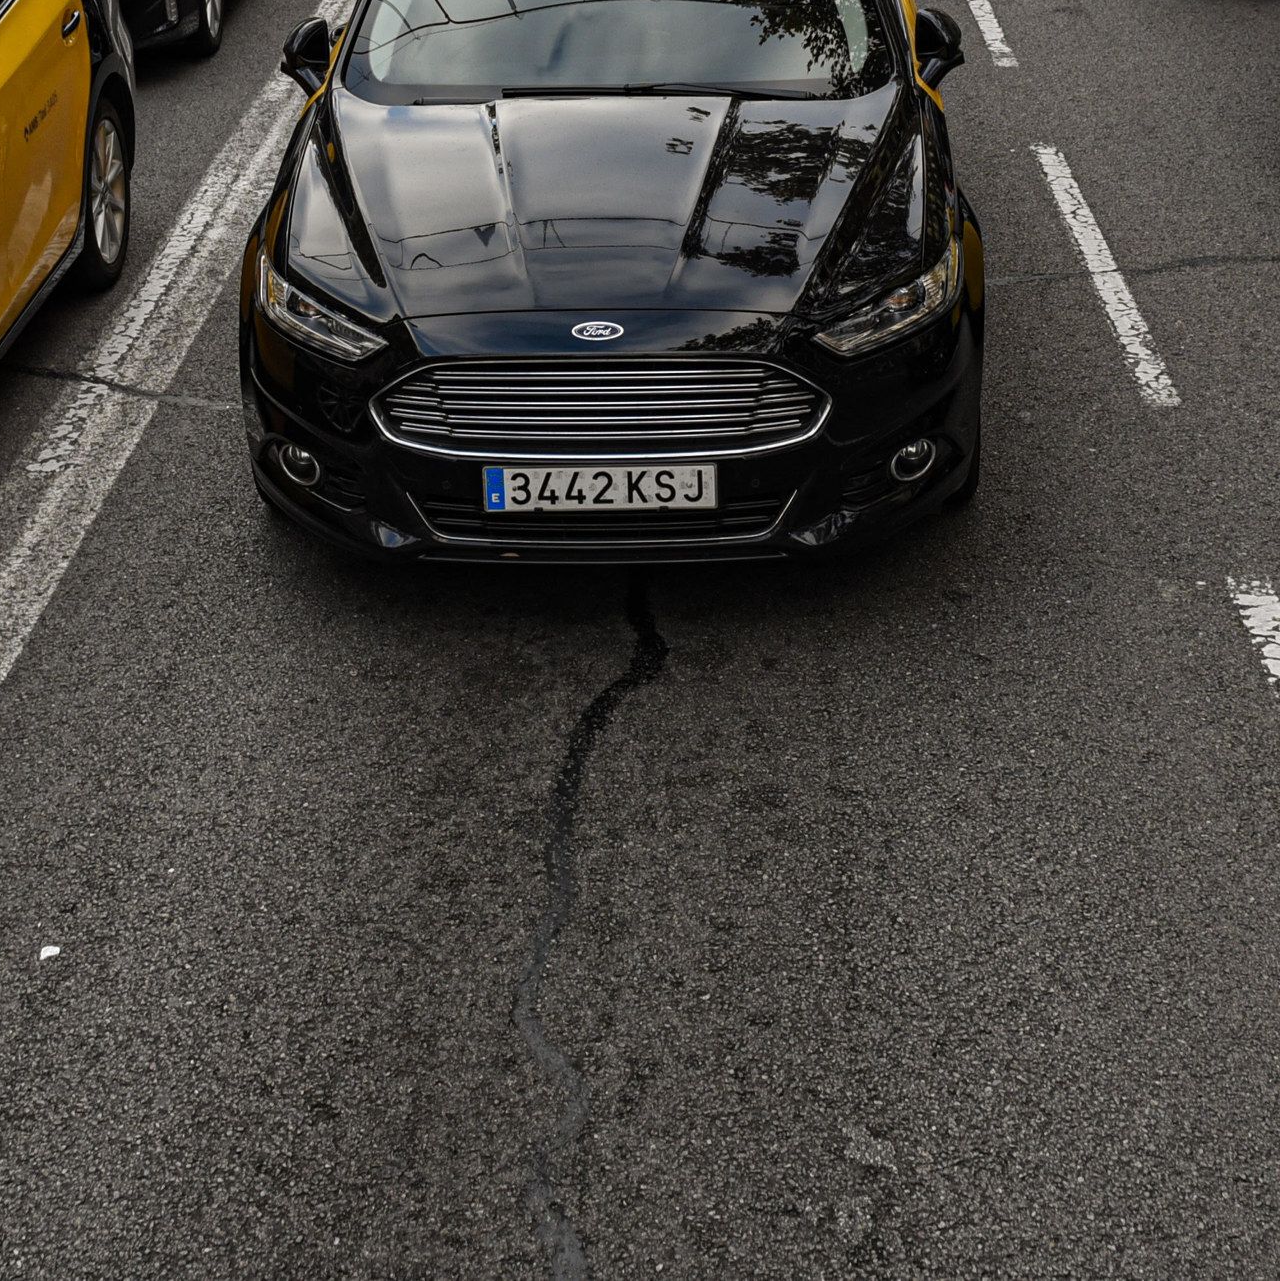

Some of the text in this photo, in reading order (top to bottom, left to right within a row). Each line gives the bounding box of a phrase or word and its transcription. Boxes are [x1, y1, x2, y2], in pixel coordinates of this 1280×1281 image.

[583, 325, 612, 337] Ford
[491, 470, 704, 506] E 3442 KSJ
